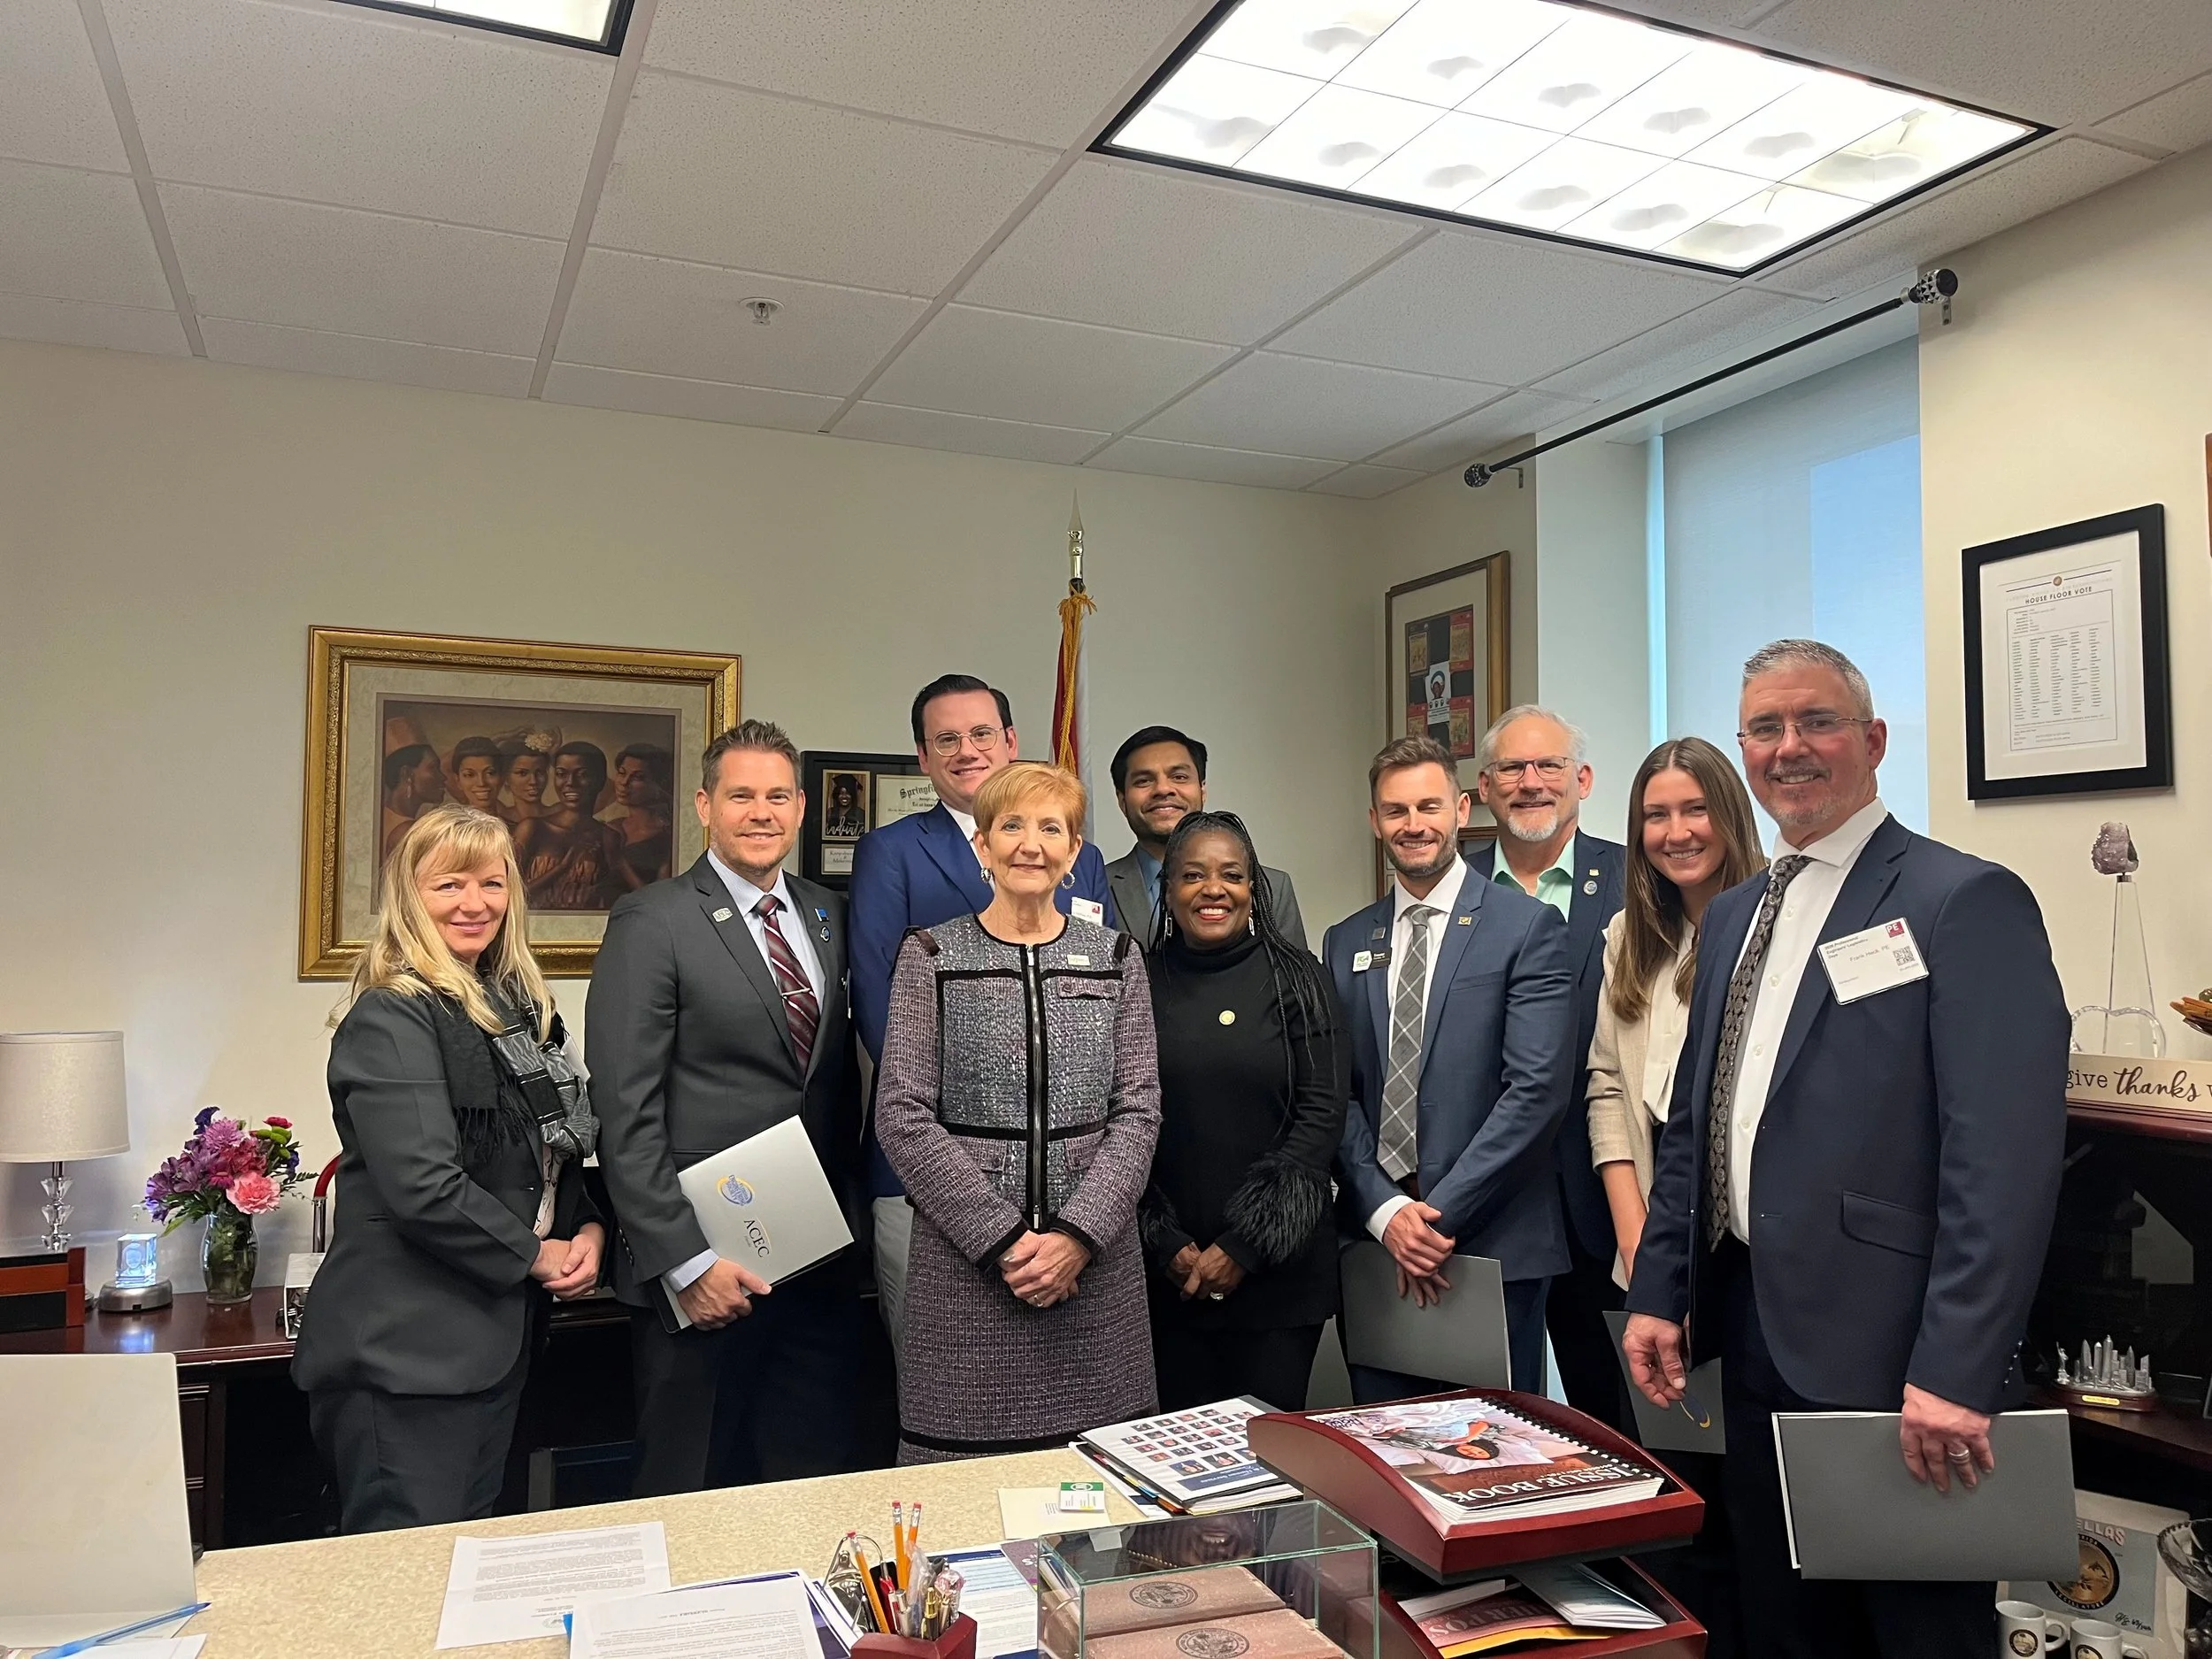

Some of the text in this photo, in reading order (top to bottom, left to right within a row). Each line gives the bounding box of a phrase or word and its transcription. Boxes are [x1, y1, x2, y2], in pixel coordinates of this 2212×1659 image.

[2024, 586, 2093, 604] HOUSE FLOOR VOTE
[1886, 923, 1900, 933] PE
[2066, 1070, 2108, 1089] give
[2113, 1066, 2201, 1102] thanks
[743, 1218, 770, 1258] ACEC
[1537, 1467, 1634, 1488] ISSUE
[1440, 1480, 1539, 1503] BOOK
